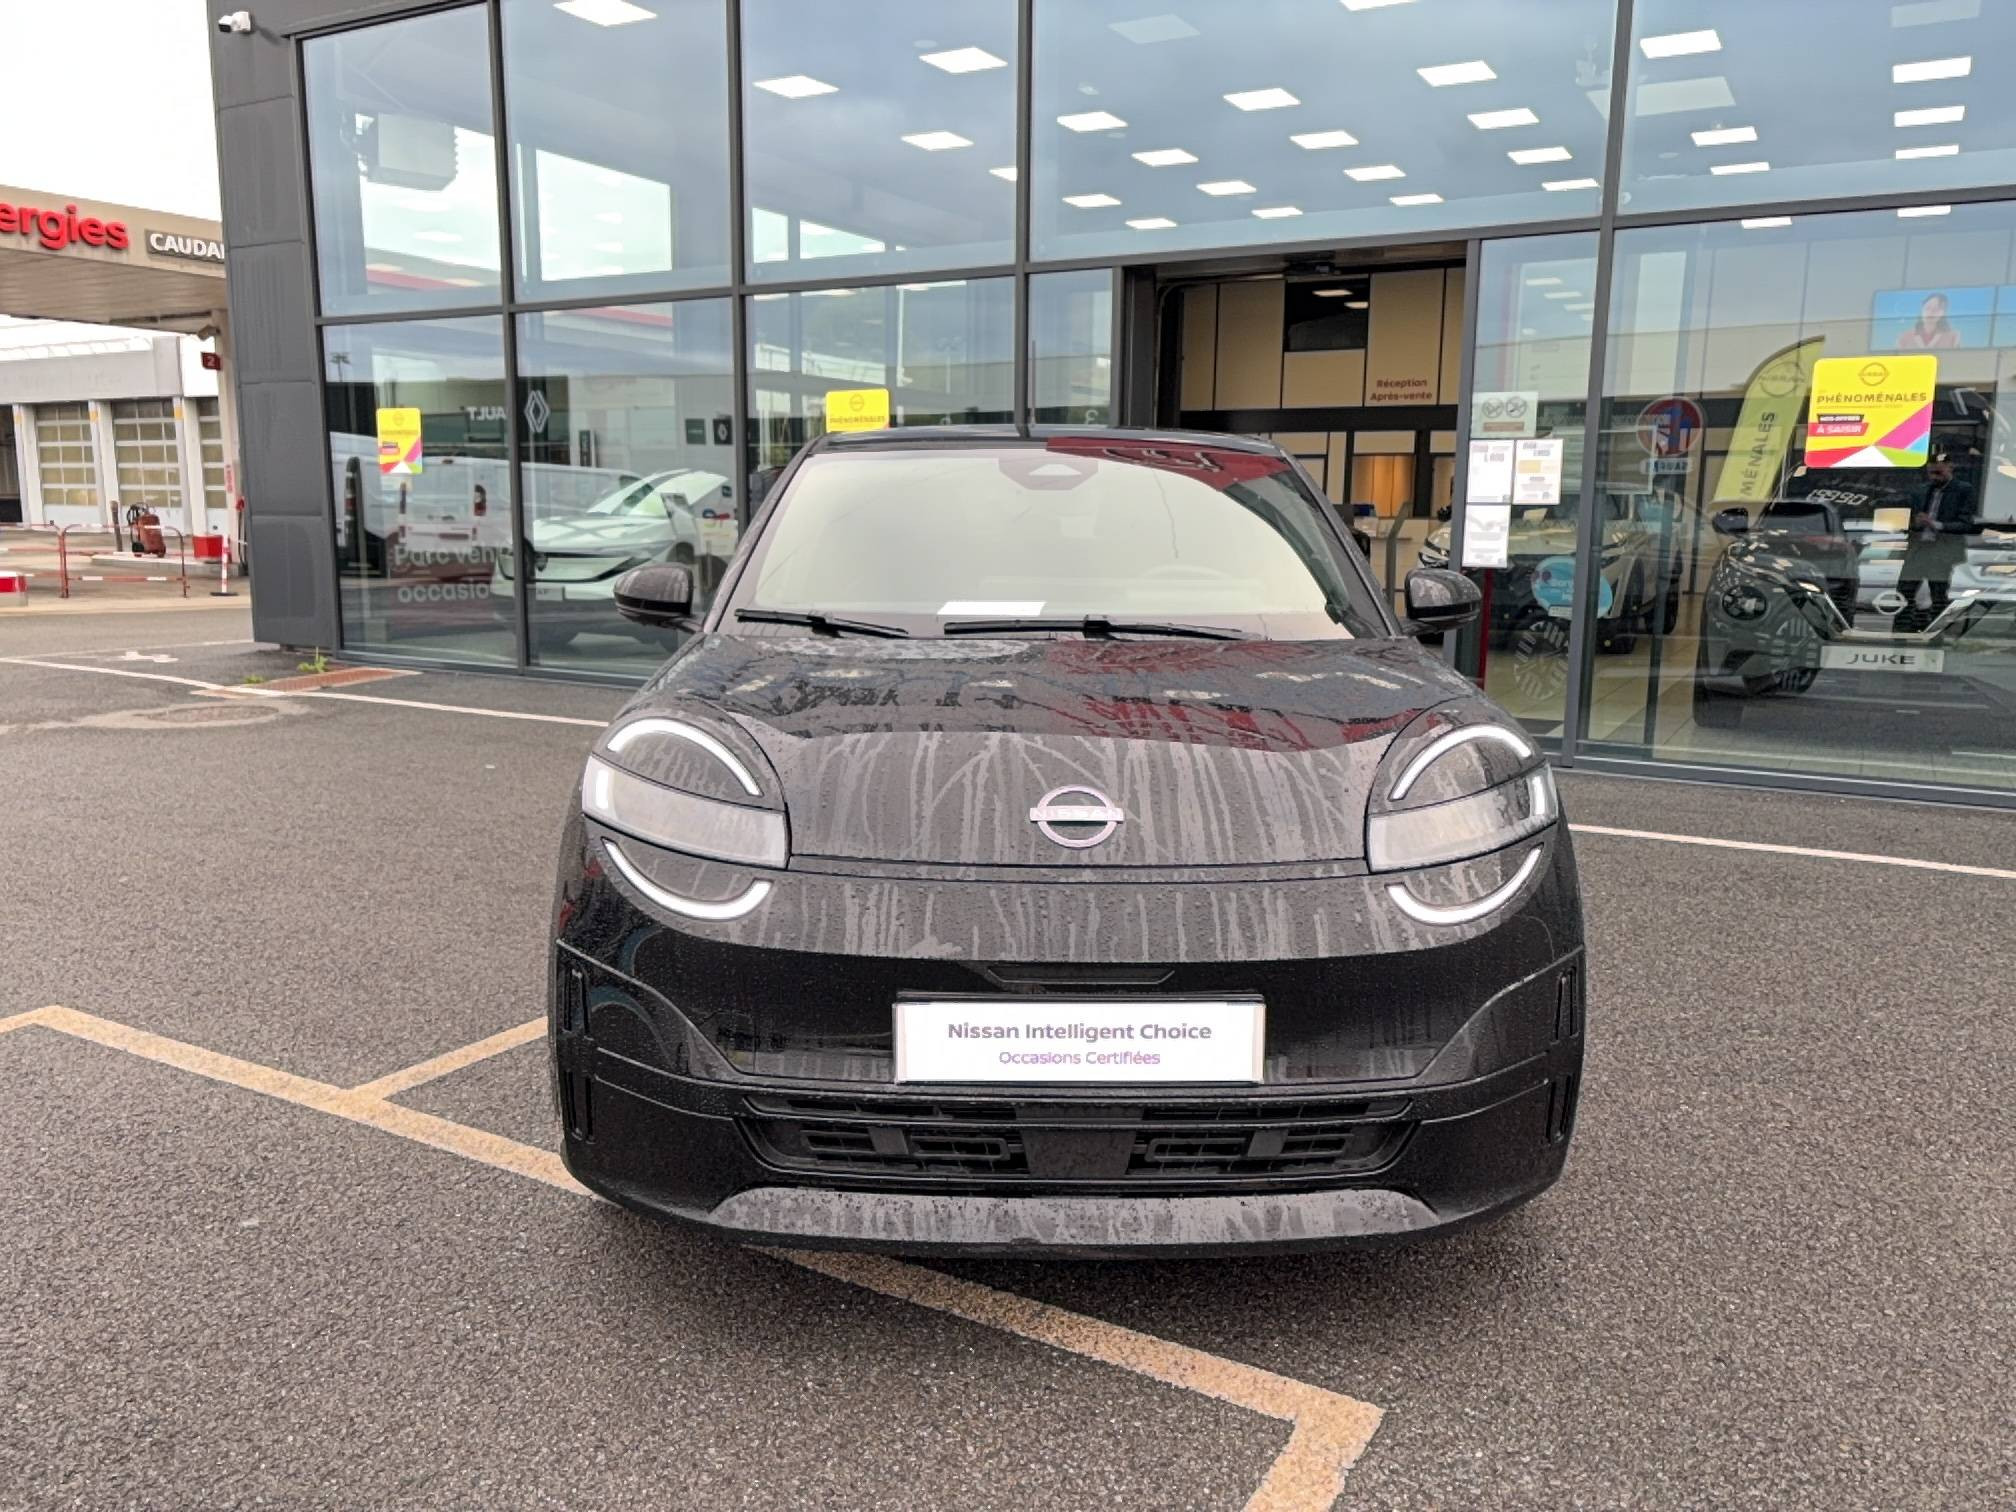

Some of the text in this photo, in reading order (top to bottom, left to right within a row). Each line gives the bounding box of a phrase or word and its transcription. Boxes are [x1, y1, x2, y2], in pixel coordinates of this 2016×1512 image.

[0, 202, 130, 250] ergies
[1376, 378, 1428, 389] Réception
[1370, 391, 1433, 402] Après-vente
[1816, 391, 1927, 404] PHÉNOMÉNALES
[1847, 652, 1916, 665] JUKE
[948, 1022, 1212, 1043] Nissan Intelligent Choice
[999, 1050, 1161, 1065] Occasions Certifiées
